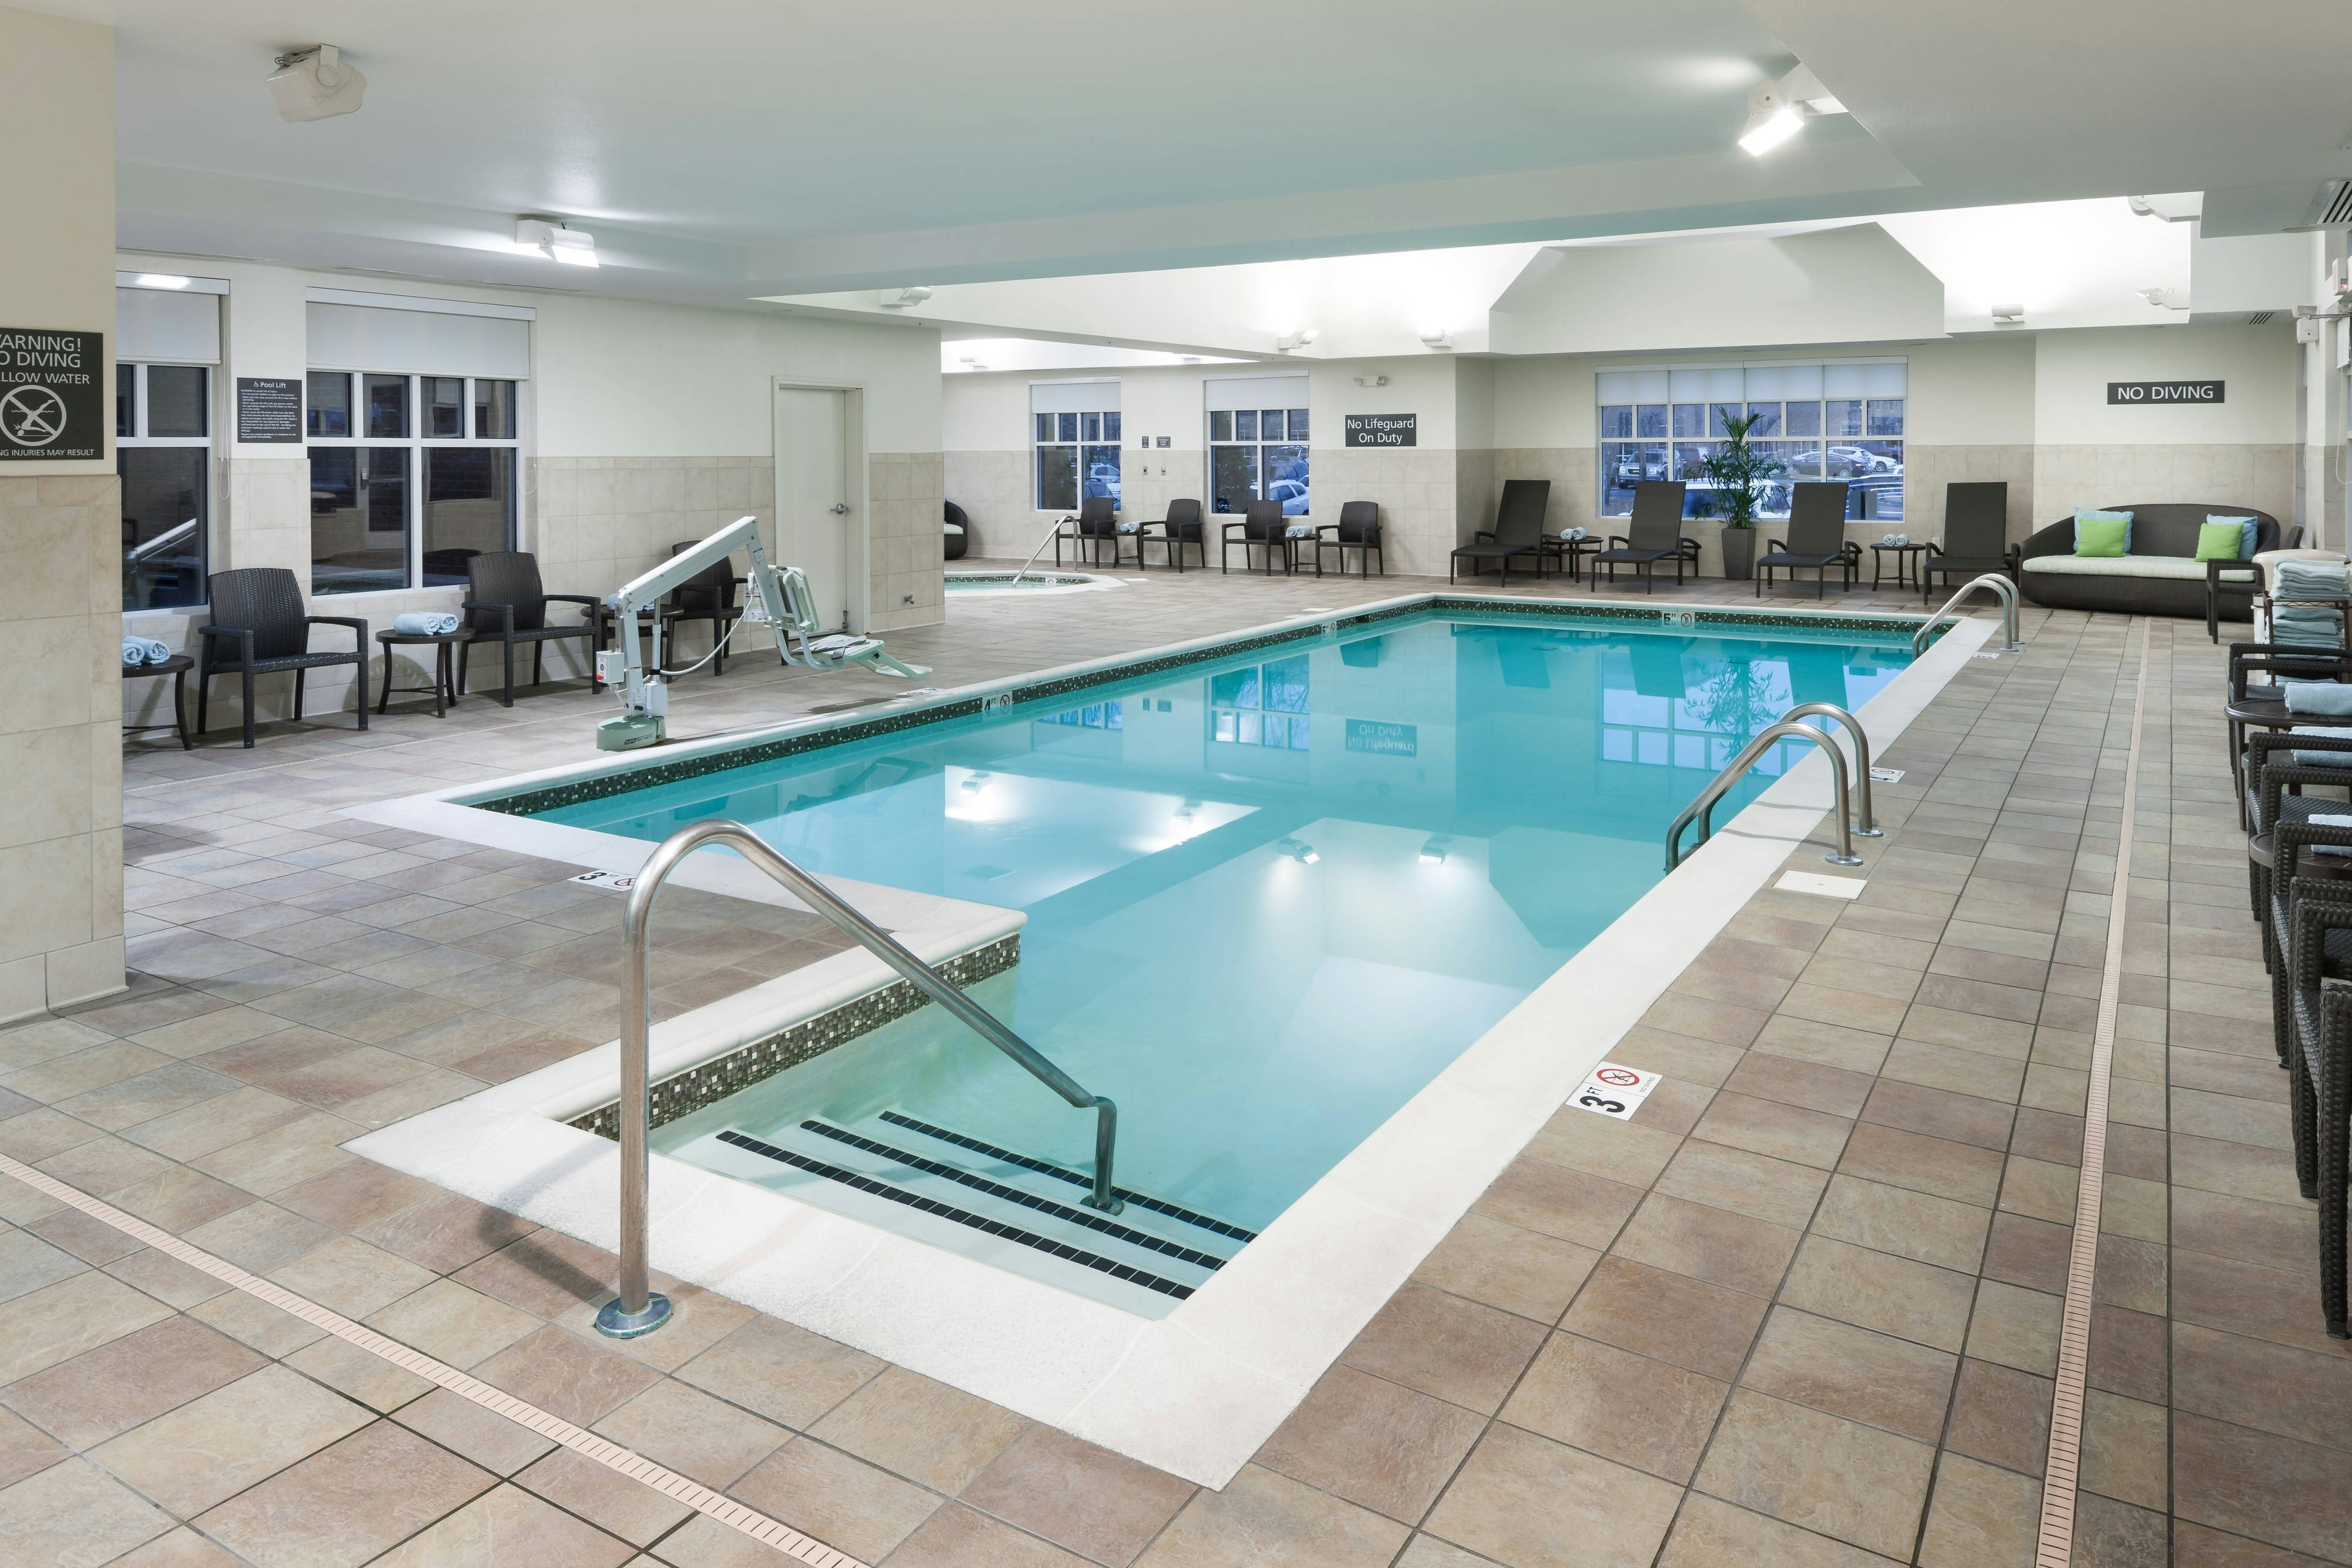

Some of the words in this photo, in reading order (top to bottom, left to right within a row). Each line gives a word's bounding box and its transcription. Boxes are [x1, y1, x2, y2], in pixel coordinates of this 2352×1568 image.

[0, 335, 81, 352] ARNING!
[0, 350, 10, 365] O
[17, 352, 80, 367] DIVING
[45, 374, 90, 384] WATER
[2118, 387, 2144, 400] NO
[2152, 386, 2213, 399] DIVING
[1347, 419, 1362, 429] No
[1365, 417, 1414, 431] Lifeguard
[1359, 433, 1374, 442] On
[1377, 433, 1402, 445] Duty
[578, 872, 607, 880] 3
[1586, 1086, 1603, 1095] FT
[1579, 1096, 1626, 1113] 3
